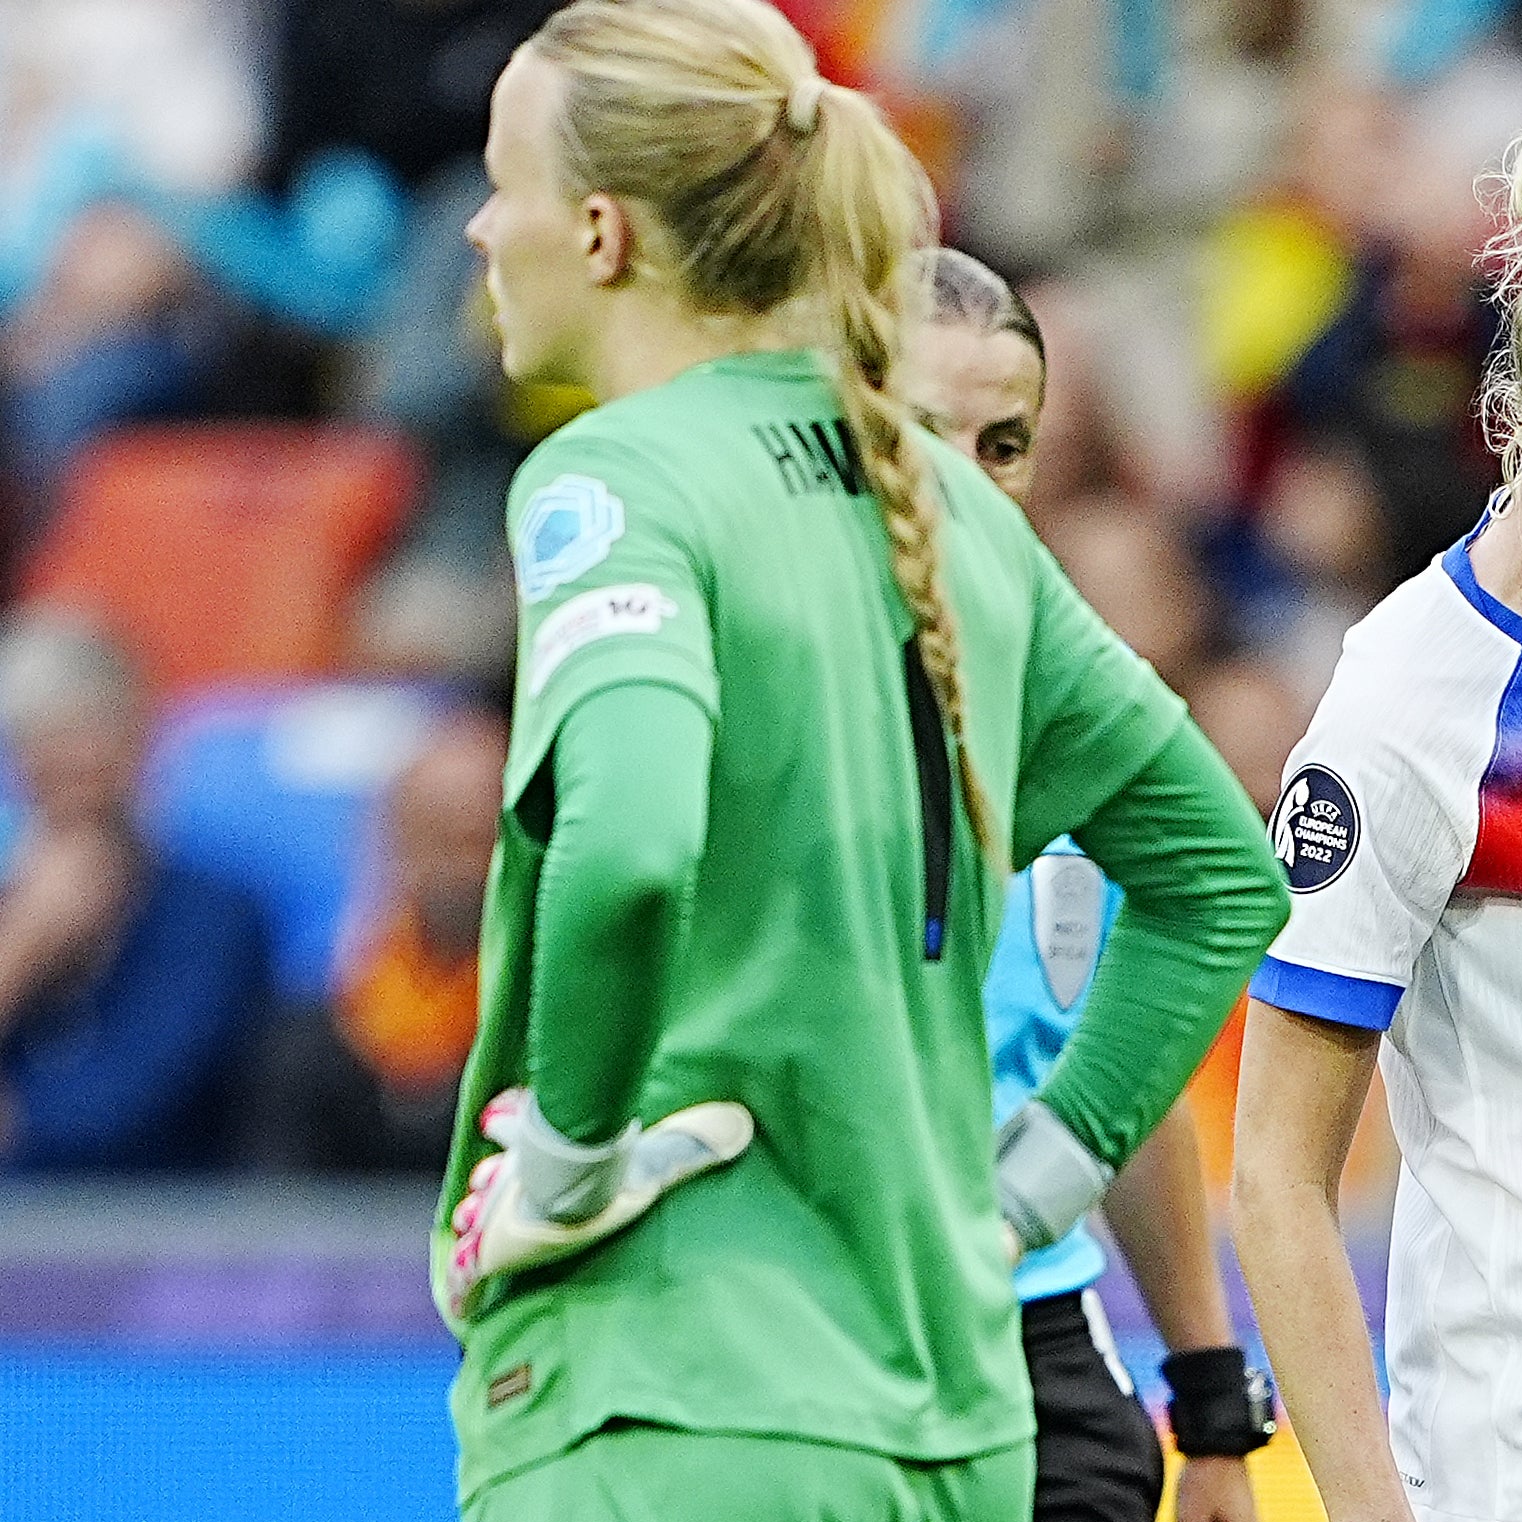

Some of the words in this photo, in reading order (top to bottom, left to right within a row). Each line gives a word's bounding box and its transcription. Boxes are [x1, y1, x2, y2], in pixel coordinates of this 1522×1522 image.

[1294, 826, 1347, 850] CHAMPIONS
[1298, 815, 1348, 838] EUROPEAN
[1299, 843, 1333, 863] 2022
